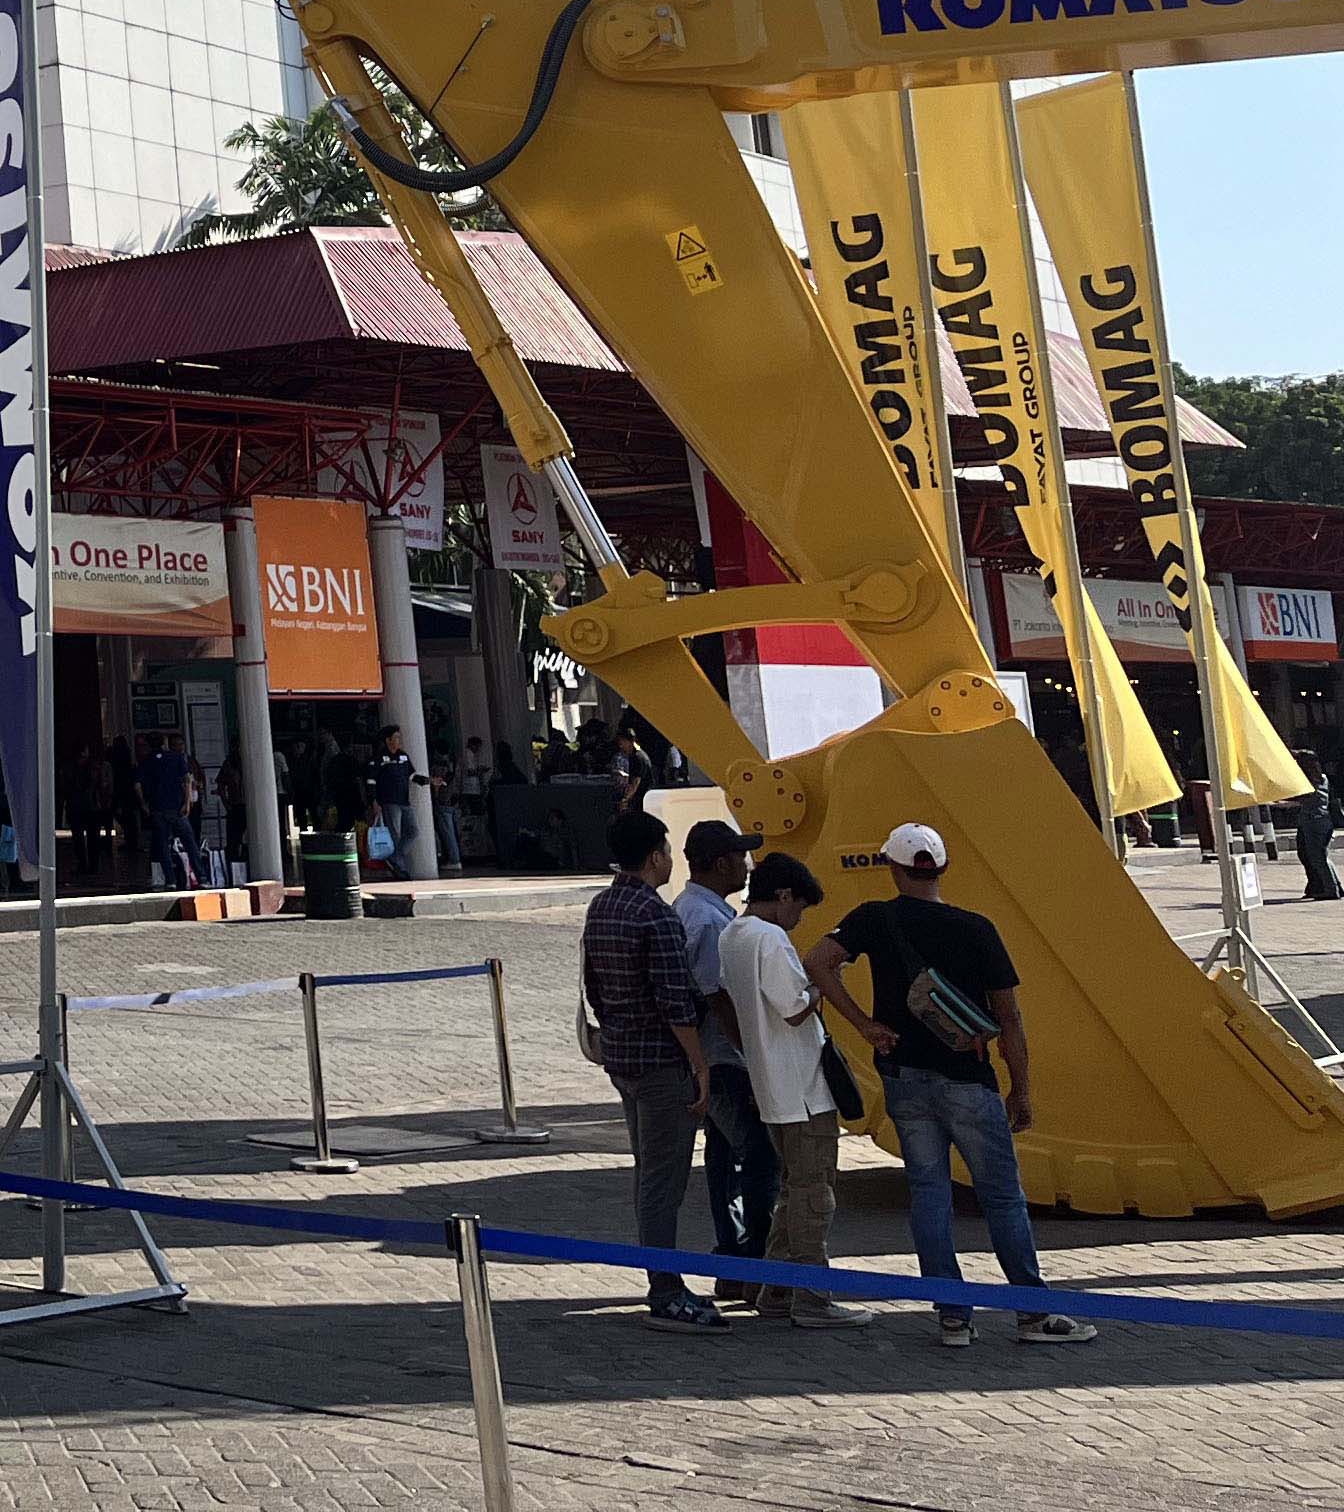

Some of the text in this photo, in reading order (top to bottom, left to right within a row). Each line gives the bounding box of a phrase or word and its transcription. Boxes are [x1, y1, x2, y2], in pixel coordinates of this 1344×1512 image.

[1013, 332, 1040, 419] GROUP
[1080, 264, 1177, 518] BOMAG
[399, 502, 431, 520] SANY
[512, 530, 545, 545] SANY
[69, 540, 128, 568] One
[138, 544, 209, 573] Place
[52, 570, 210, 587] ntive, Convention, and Exhibition
[303, 564, 365, 616] BNI
[1117, 597, 1175, 619] All In On
[1278, 593, 1322, 639] BNI
